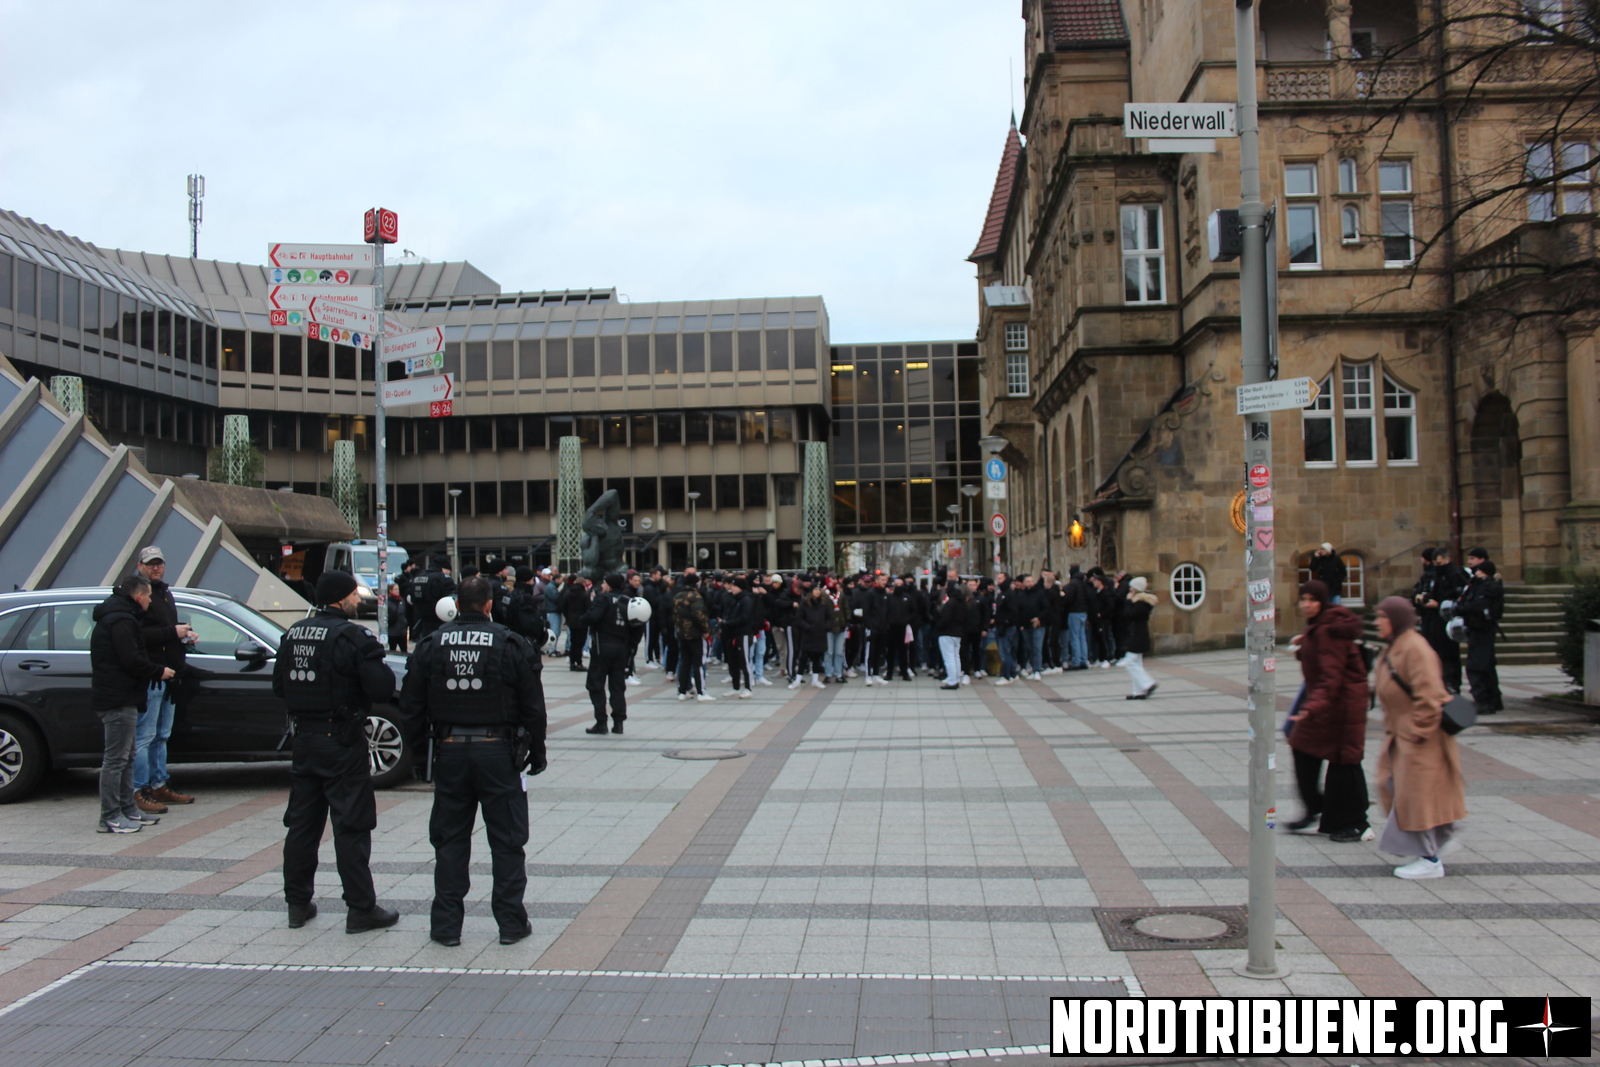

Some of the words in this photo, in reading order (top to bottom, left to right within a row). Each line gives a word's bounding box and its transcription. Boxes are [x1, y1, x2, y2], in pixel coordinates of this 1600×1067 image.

[1130, 110, 1225, 130] Niederwall
[384, 215, 394, 229] 22
[310, 252, 354, 261] Hauptbahnhof
[322, 302, 358, 319] Sparrenburg
[322, 314, 345, 326] Altstadt
[384, 341, 417, 354] BI-Stieghorst
[385, 388, 412, 399] BI-Quelle
[286, 626, 329, 641] POLIZEI
[440, 631, 493, 646] POLIZEI
[293, 644, 316, 656] NRW
[450, 650, 480, 663] NRW
[294, 657, 309, 669] 124
[455, 664, 474, 676] 124
